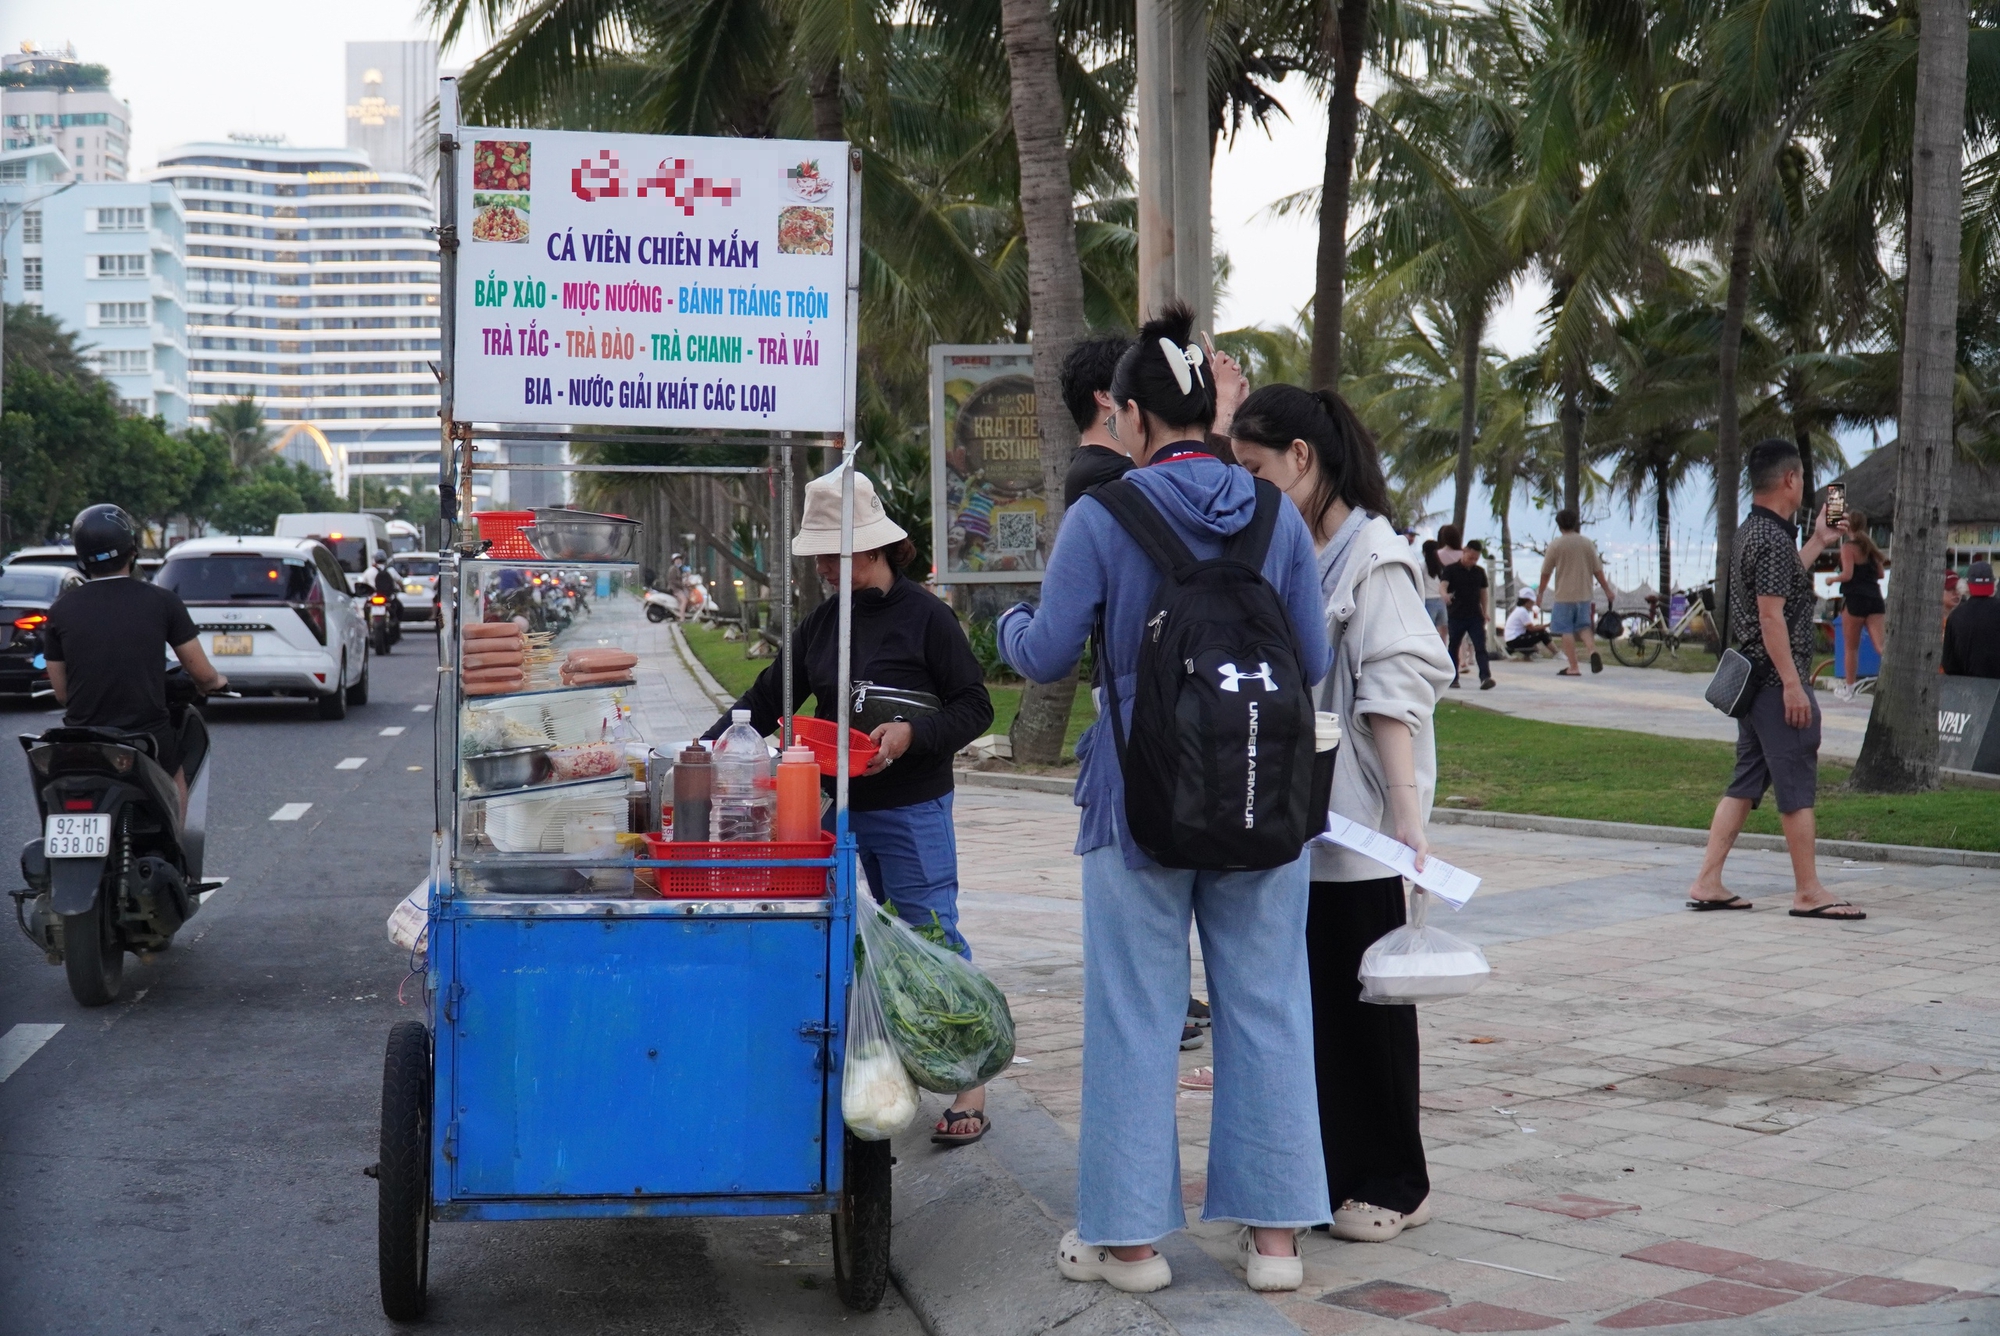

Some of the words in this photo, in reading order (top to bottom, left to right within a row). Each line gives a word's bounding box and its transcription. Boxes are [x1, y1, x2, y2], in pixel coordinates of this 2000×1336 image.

[547, 226, 577, 262] CÁ
[582, 229, 632, 264] VIÊN
[638, 231, 702, 267] CHIÊN
[708, 229, 759, 269] MẮM
[475, 270, 508, 308] BẮP
[513, 275, 547, 310] XÀO
[563, 281, 600, 317] MỰC
[606, 280, 663, 314] NƯỚNG
[678, 282, 725, 316] BÁNH
[728, 283, 782, 318] TRÁNG
[786, 286, 829, 325] TRỘN
[482, 323, 514, 356] TRÀ
[518, 319, 549, 357] TẮC
[566, 326, 596, 358] TRÀ
[601, 327, 634, 360] ĐÀO
[651, 329, 683, 362] TRÀ
[687, 335, 743, 364] CHANH
[758, 332, 789, 365] TRÀ
[793, 330, 819, 366] VẢI
[525, 377, 553, 405] BIA
[569, 374, 614, 408] NƯỚC
[620, 373, 652, 409] GIẢI
[657, 377, 699, 410] KHÁT
[704, 378, 736, 412] CÁC
[741, 385, 776, 419] LOẠI
[1017, 393, 1037, 414] SU
[974, 416, 1039, 438] KRAFTBE
[983, 439, 1040, 460] FESTIVA
[1248, 701, 1258, 757] UNDER
[1245, 759, 1257, 829] ARMOUR
[50, 837, 105, 853] 638.06
[57, 818, 98, 835] 92-H1
